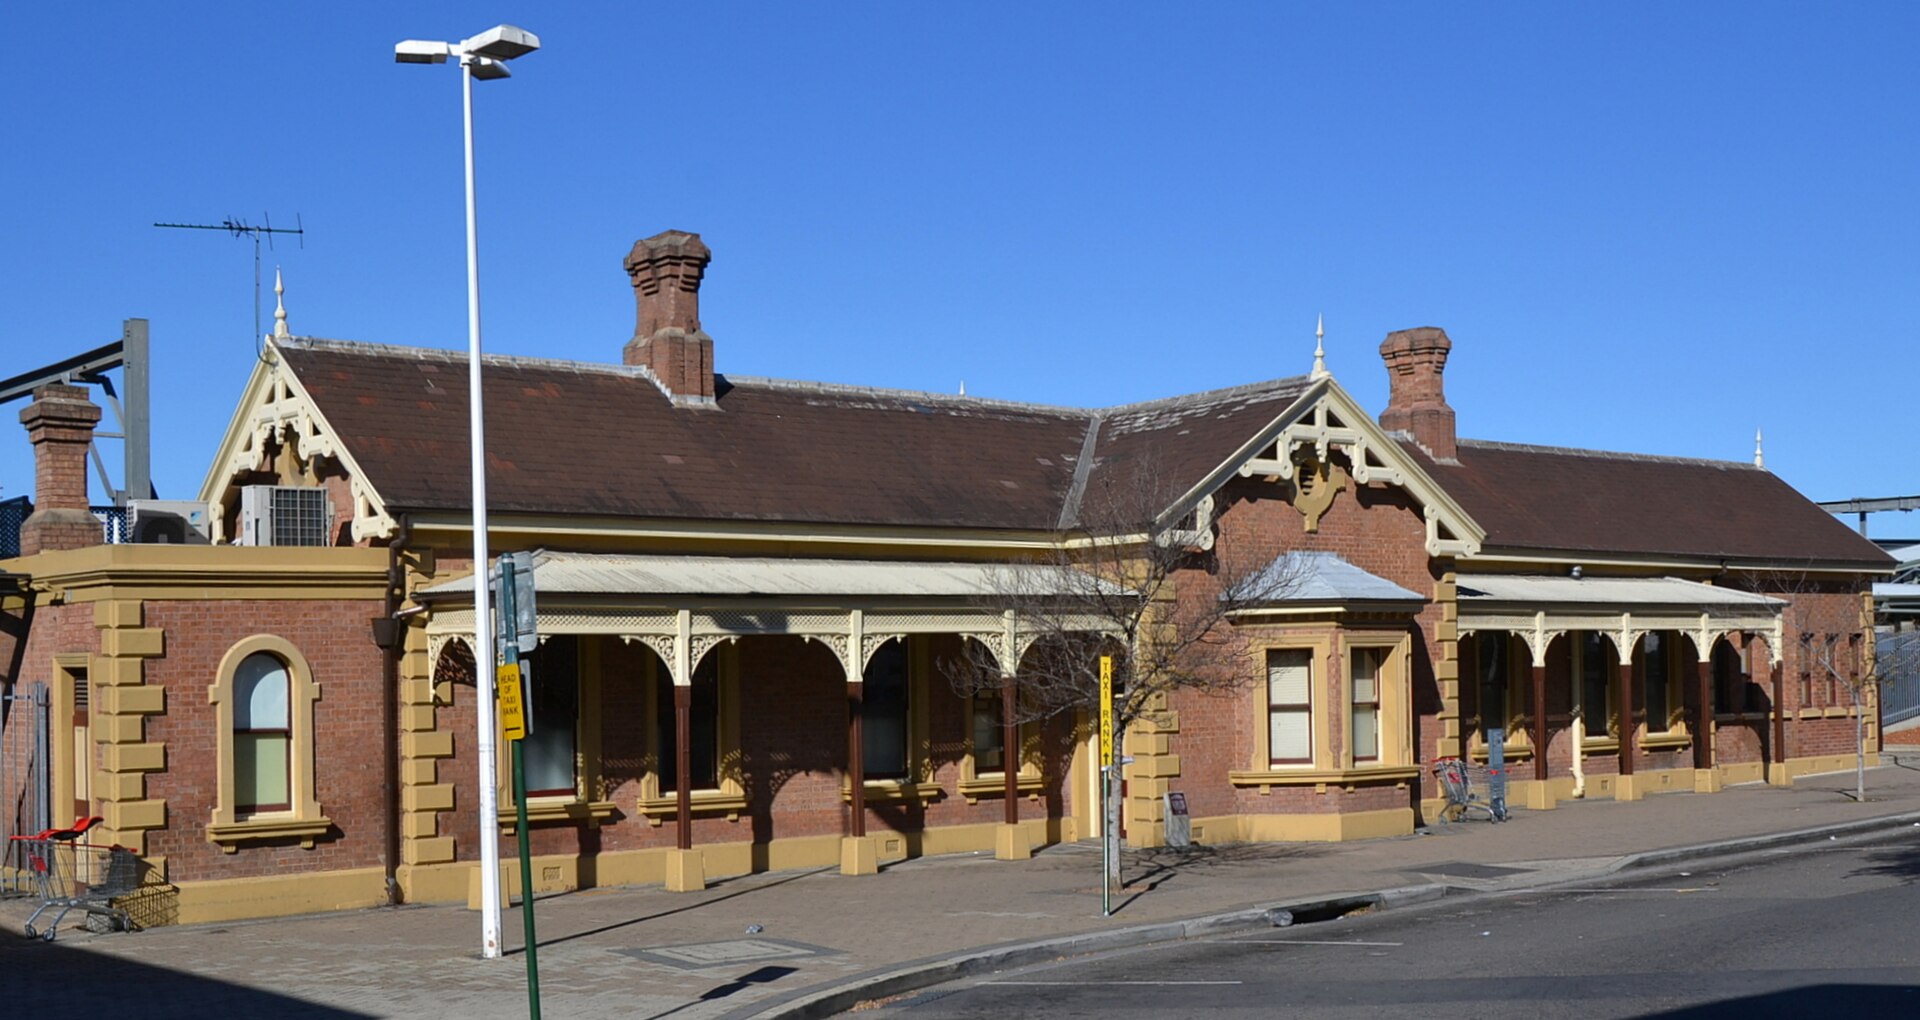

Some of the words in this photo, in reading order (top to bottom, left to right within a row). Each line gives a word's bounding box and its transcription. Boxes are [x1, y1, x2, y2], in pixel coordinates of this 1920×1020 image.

[503, 684, 512, 694] OF
[1102, 662, 1110, 699] TAXI
[1102, 710, 1110, 747] RANK
